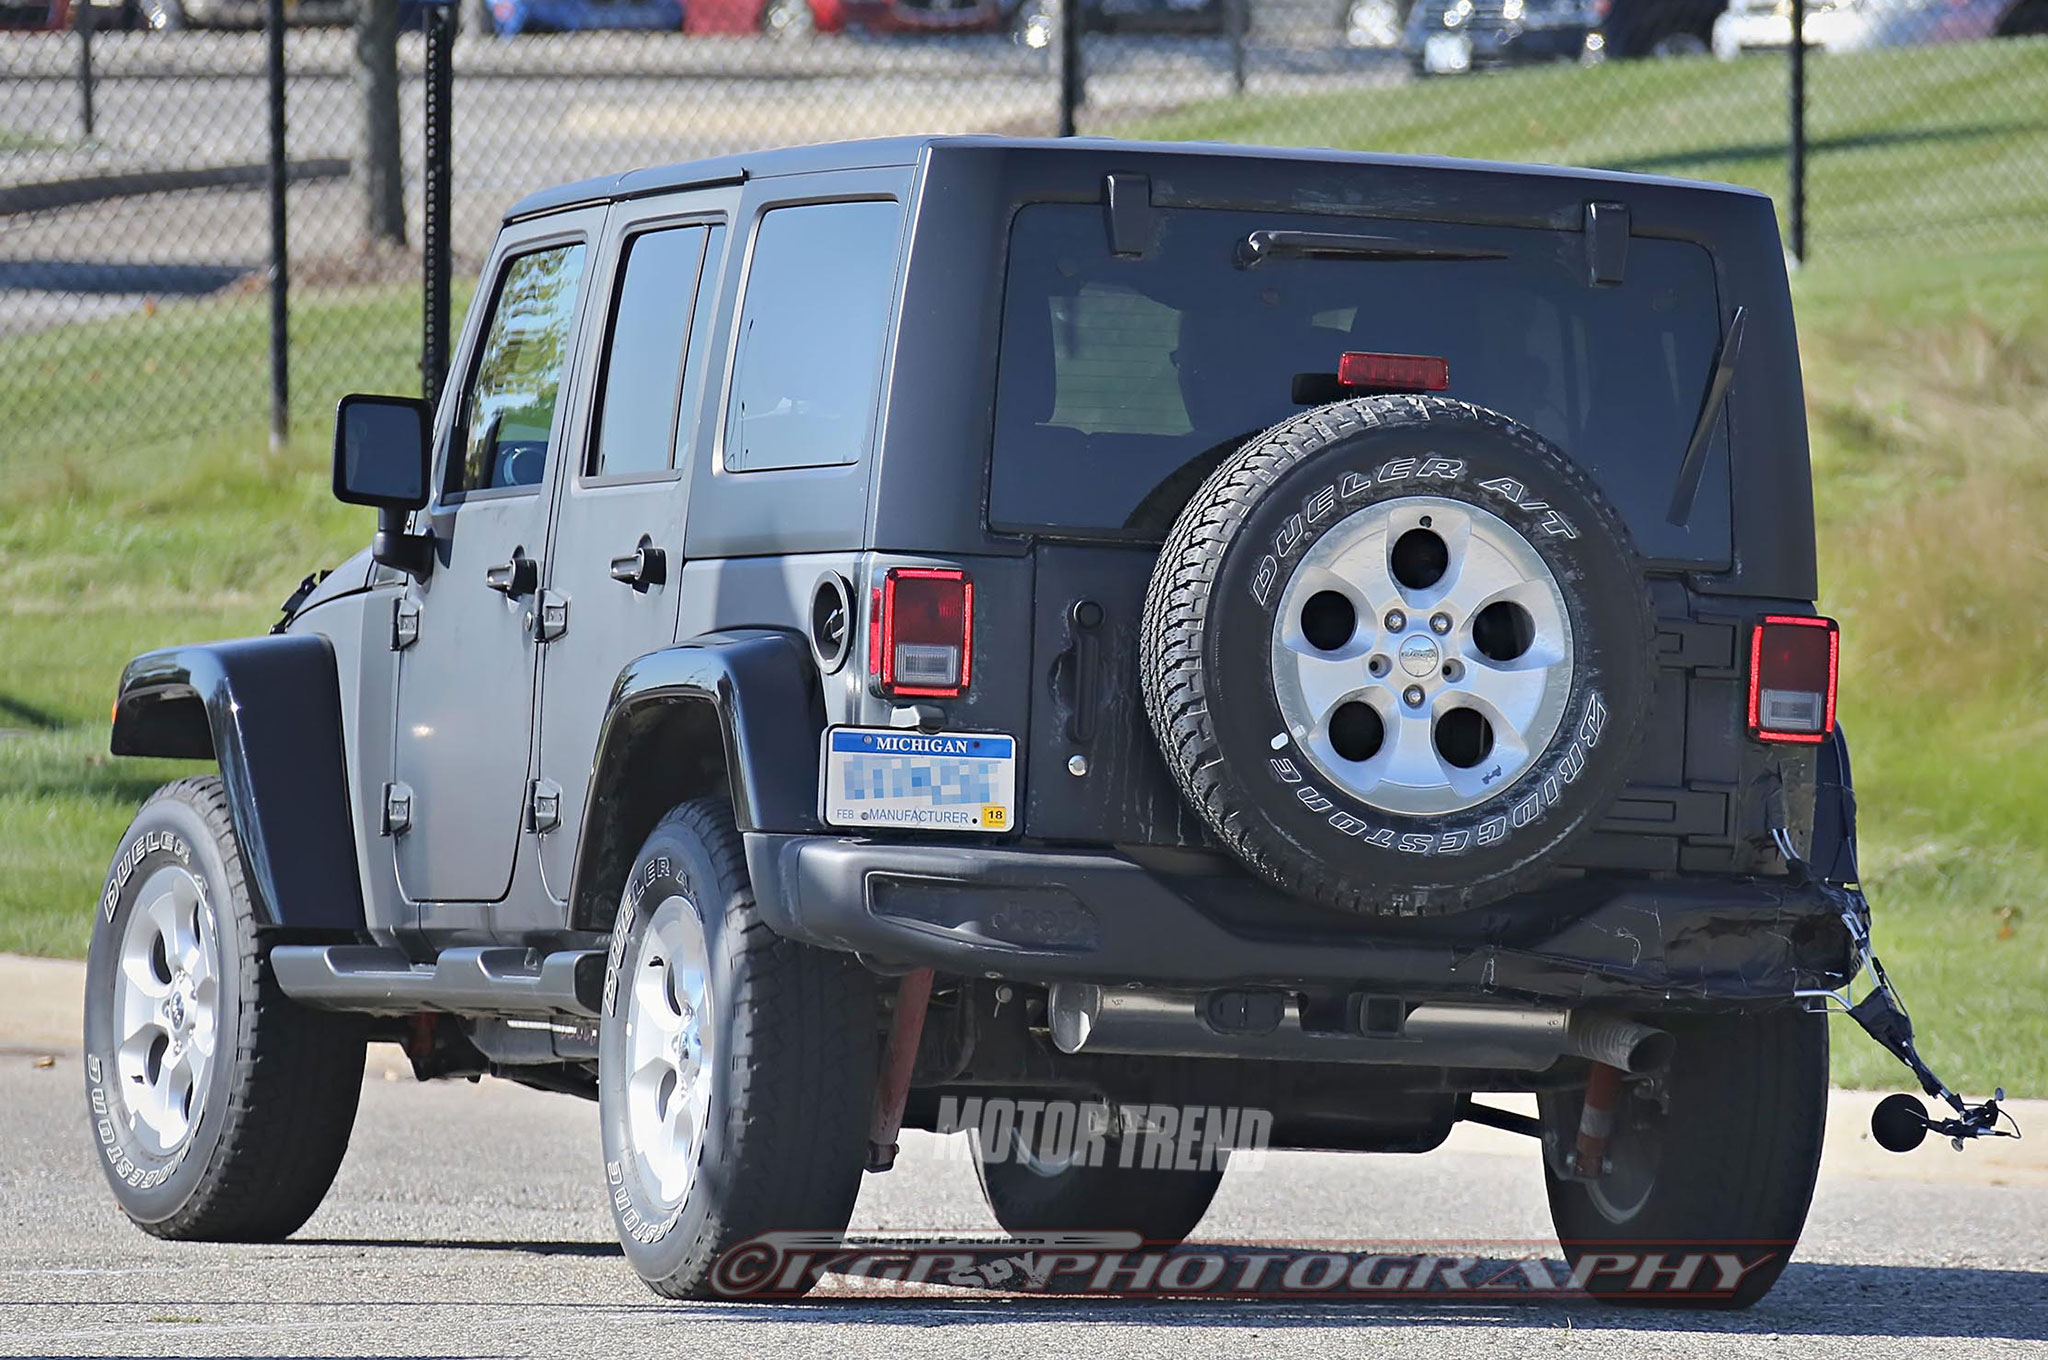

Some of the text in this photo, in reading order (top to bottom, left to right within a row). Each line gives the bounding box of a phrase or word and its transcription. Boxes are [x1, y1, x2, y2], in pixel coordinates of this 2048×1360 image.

[1251, 457, 1464, 606] DUELER
[876, 736, 968, 754] MICHIGAN
[1270, 693, 1607, 854] BRIDGESTONE
[836, 808, 968, 824] FEB MANUFACTURER
[988, 810, 1003, 820] 18
[104, 830, 191, 924] DUELER
[604, 857, 671, 1017] DUELER
